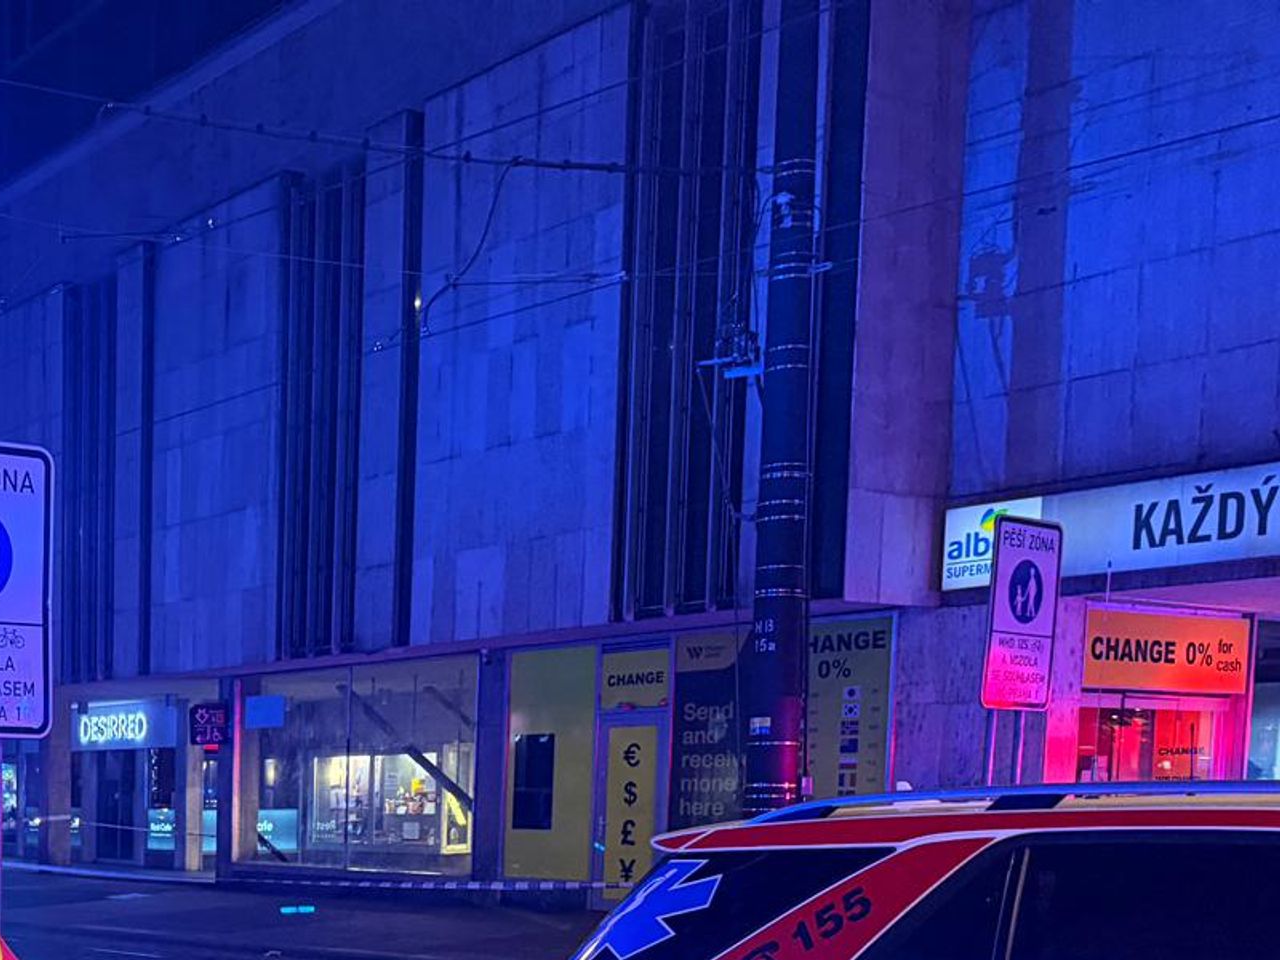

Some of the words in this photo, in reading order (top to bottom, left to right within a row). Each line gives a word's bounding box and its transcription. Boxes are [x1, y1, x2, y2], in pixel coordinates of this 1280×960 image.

[1132, 474, 1280, 550] KAŽDÝ
[948, 532, 991, 560] alb
[1003, 527, 1027, 549] PĚŠÍ
[1028, 531, 1055, 552] ZÓNA
[946, 564, 991, 579] SUPERM
[809, 630, 886, 654] HANGE
[1091, 636, 1176, 664] CHANGE
[1185, 642, 1213, 667] 0%
[1217, 639, 1233, 655] for
[818, 657, 852, 679] 0%
[1216, 658, 1242, 673] cash
[607, 670, 665, 688] CHANGE
[683, 702, 734, 722] Send
[79, 712, 147, 745] DESIRRED
[683, 727, 719, 746] and
[681, 750, 746, 769] receiv
[680, 774, 740, 793] mone
[679, 798, 725, 817] here
[792, 887, 872, 951] 155
